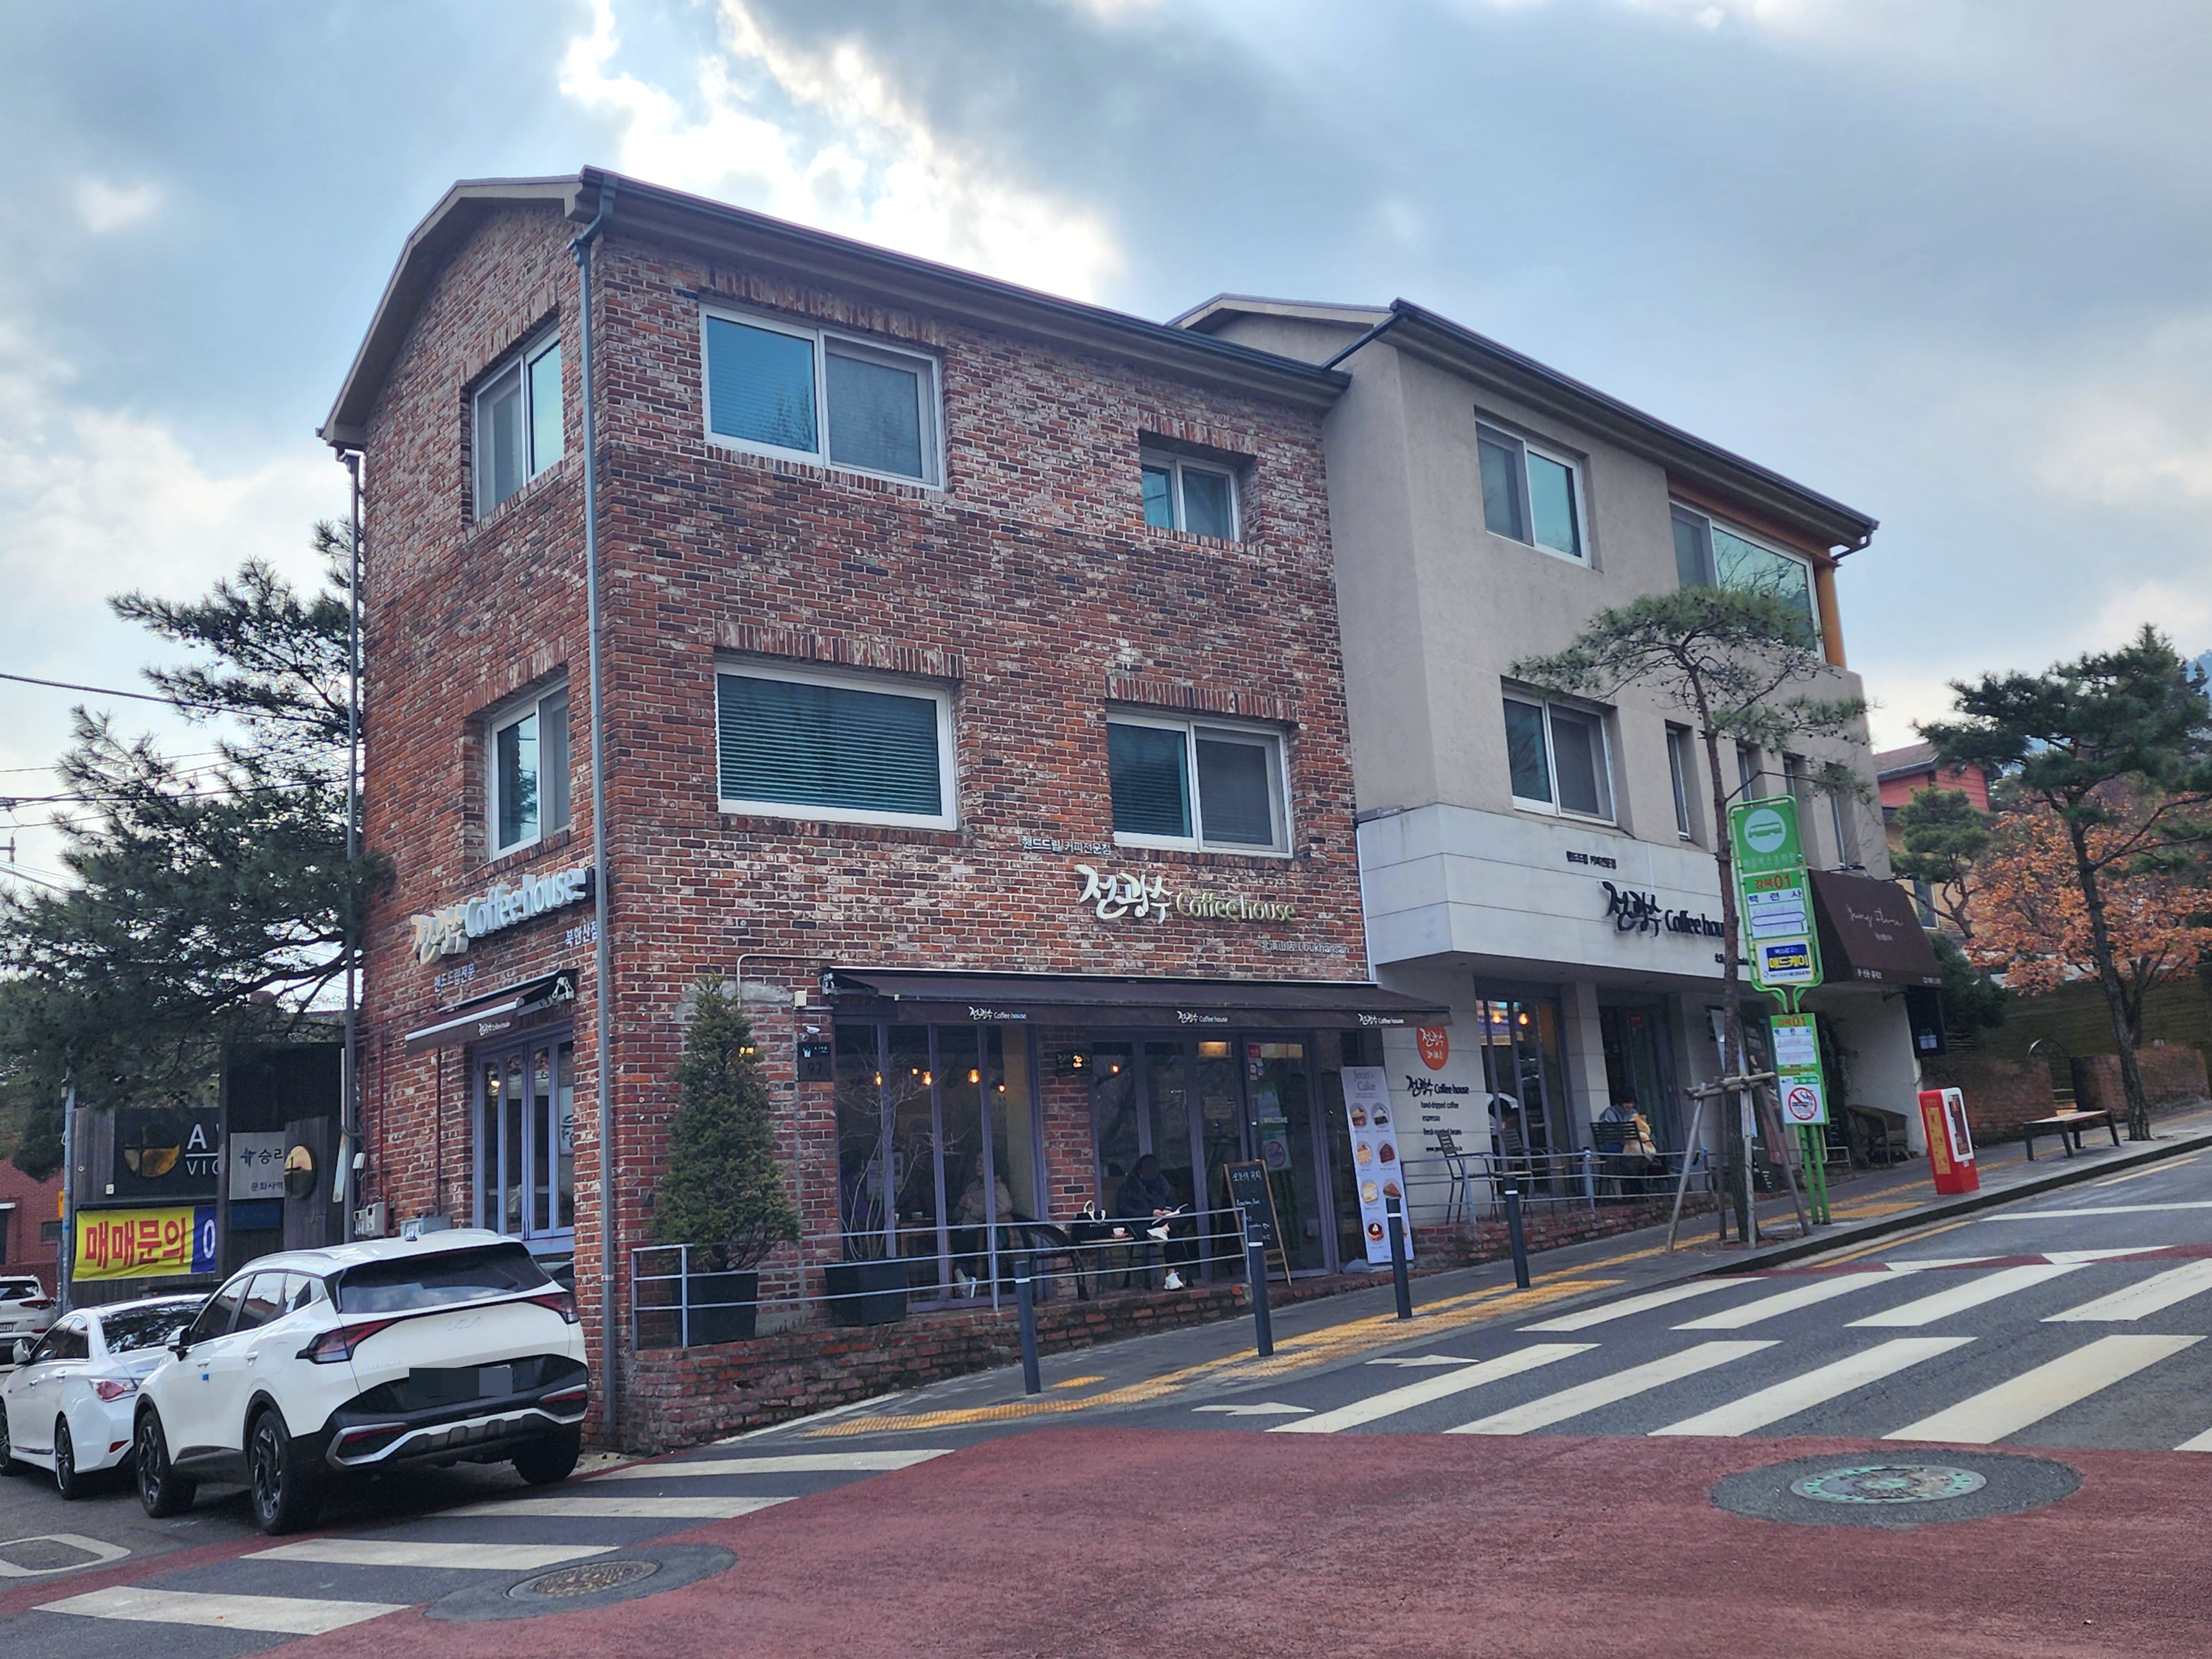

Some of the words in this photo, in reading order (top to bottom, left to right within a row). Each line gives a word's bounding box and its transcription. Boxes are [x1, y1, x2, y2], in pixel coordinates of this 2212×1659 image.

[1064, 840, 1112, 855] 커피전문점
[1075, 863, 1174, 924] 전광수
[1176, 891, 1240, 921] Coffee
[1240, 894, 1297, 922] house
[1601, 880, 1663, 938] 전광수
[1665, 909, 1702, 936] Coffee
[1702, 913, 1725, 938] hou
[968, 1006, 993, 1020] 전광수
[993, 1012, 1010, 1020] Coffee
[1405, 1074, 1433, 1097] 전광수
[85, 1217, 187, 1269] 매매문의
